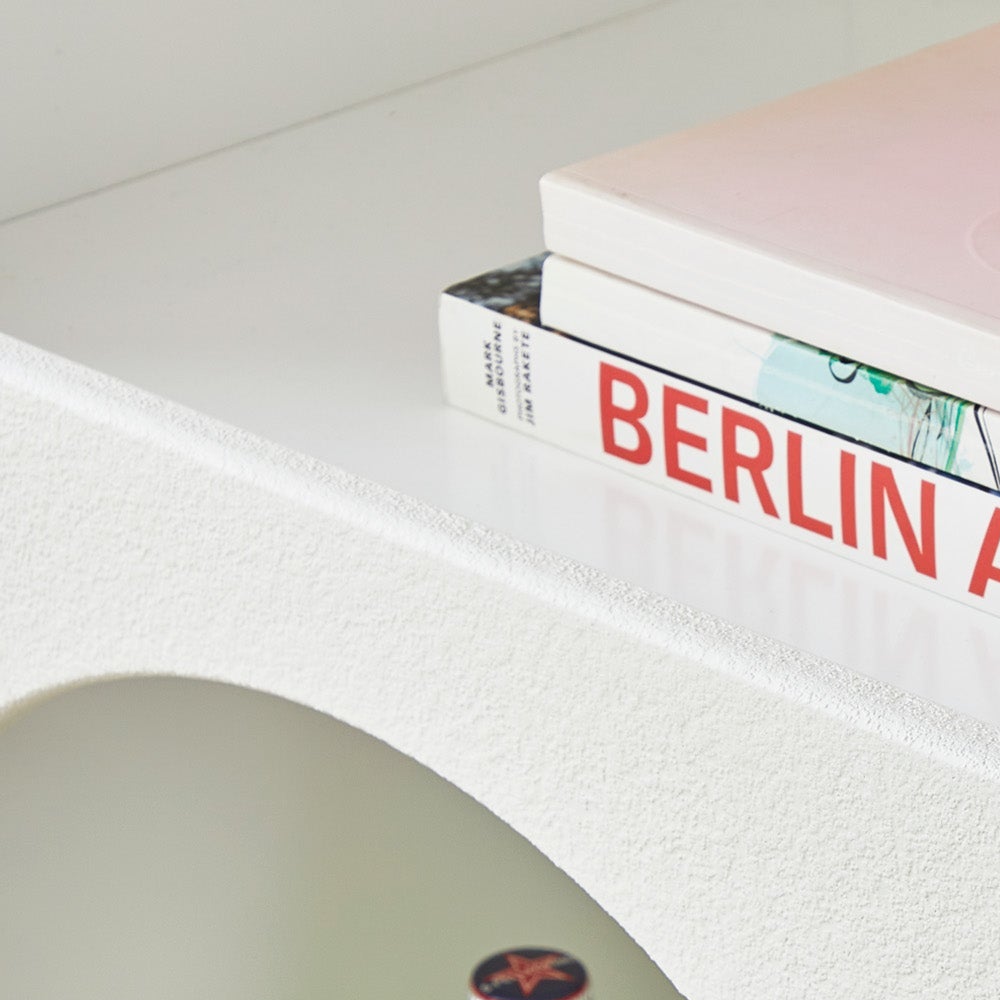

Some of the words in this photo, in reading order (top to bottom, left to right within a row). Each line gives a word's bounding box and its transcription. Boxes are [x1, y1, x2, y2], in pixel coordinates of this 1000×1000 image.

[484, 340, 494, 388] MARK
[494, 320, 506, 415] GISBOURNE
[521, 330, 532, 394] RAKETE
[525, 399, 535, 426] JIM
[600, 362, 937, 579] BERLIN
